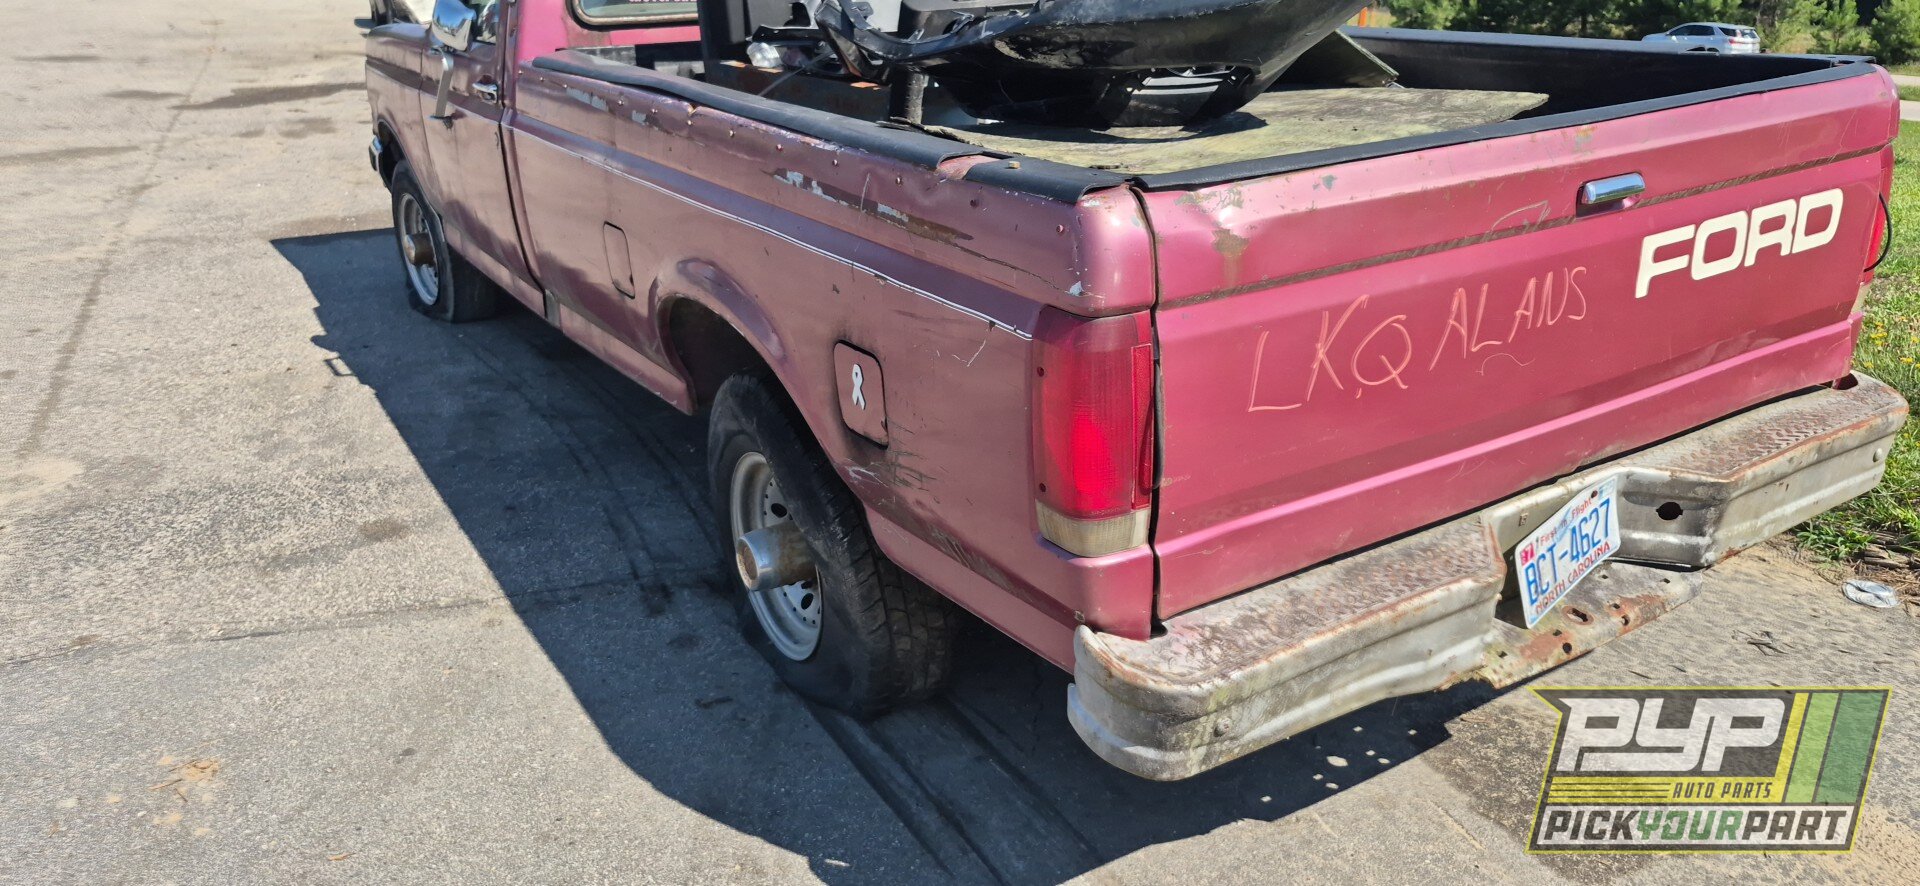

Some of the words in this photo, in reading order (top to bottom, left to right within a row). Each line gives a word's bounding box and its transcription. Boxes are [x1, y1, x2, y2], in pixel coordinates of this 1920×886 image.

[1635, 187, 1844, 299] FORD
[1248, 294, 1413, 412] LKQ
[1429, 266, 1587, 372] ALANS
[1524, 498, 1610, 606] BCT-4627
[1540, 527, 1557, 546] First
[1571, 498, 1592, 519] Flight
[1535, 580, 1566, 615] NORTH
[1567, 540, 1611, 584] CAROLINA
